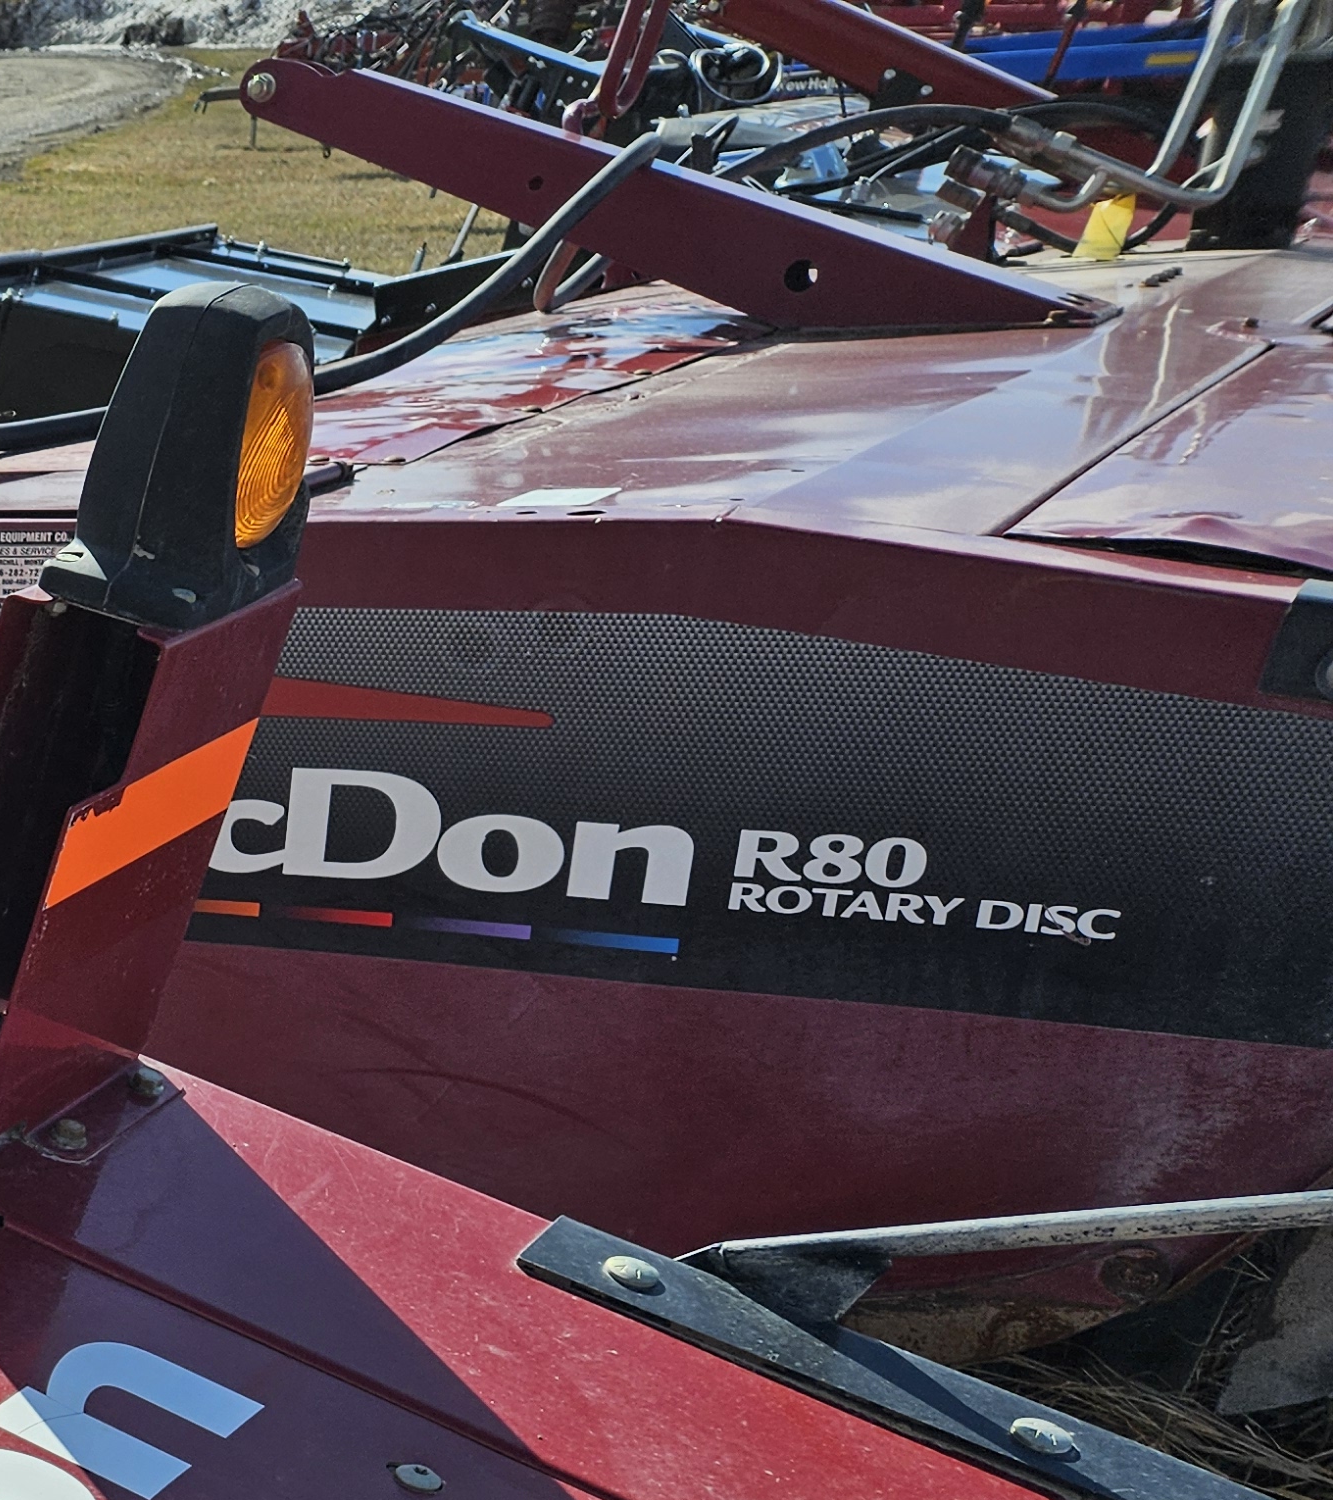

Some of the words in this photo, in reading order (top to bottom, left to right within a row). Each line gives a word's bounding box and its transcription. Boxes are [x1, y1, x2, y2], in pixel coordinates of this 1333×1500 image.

[0, 531, 53, 543] EQUIPMENT
[209, 766, 694, 906] cDon
[735, 828, 927, 889] R80
[728, 881, 965, 928] ROTARY
[976, 900, 1122, 941] DISC
